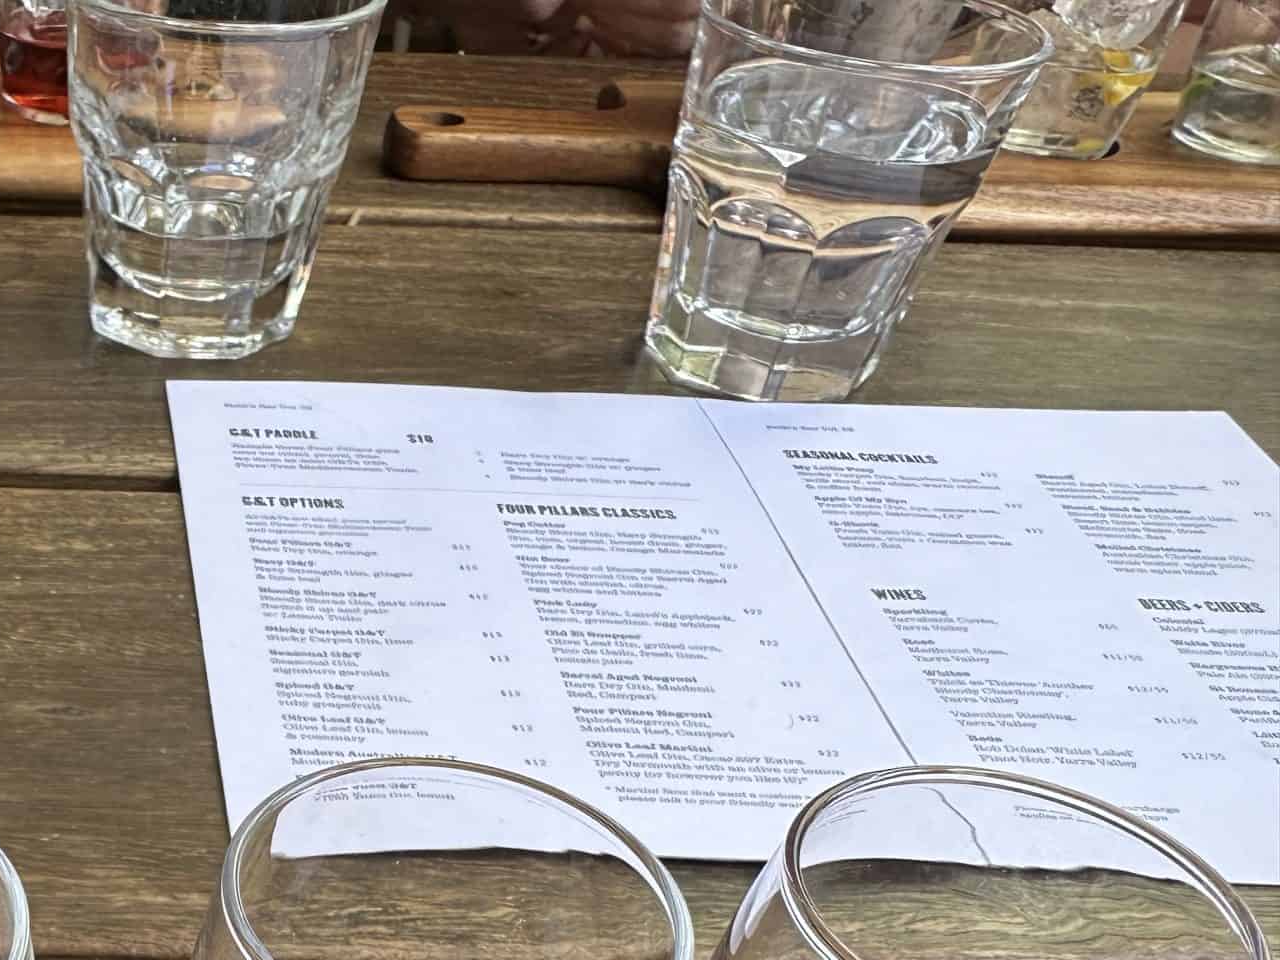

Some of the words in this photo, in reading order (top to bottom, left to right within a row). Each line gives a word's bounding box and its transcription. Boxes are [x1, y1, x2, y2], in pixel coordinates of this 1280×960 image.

[265, 429, 320, 439] PADDLE
[782, 450, 857, 460] SEASONAL
[858, 453, 938, 464] COCKTAILS
[279, 497, 345, 509] OPTIONS
[496, 504, 536, 515] FOUR
[537, 505, 600, 517] PILLARS
[602, 508, 677, 519] CLASSICS
[870, 589, 926, 600] WINES
[1137, 598, 1191, 611] BEERS
[1203, 601, 1265, 613] CIDERS
